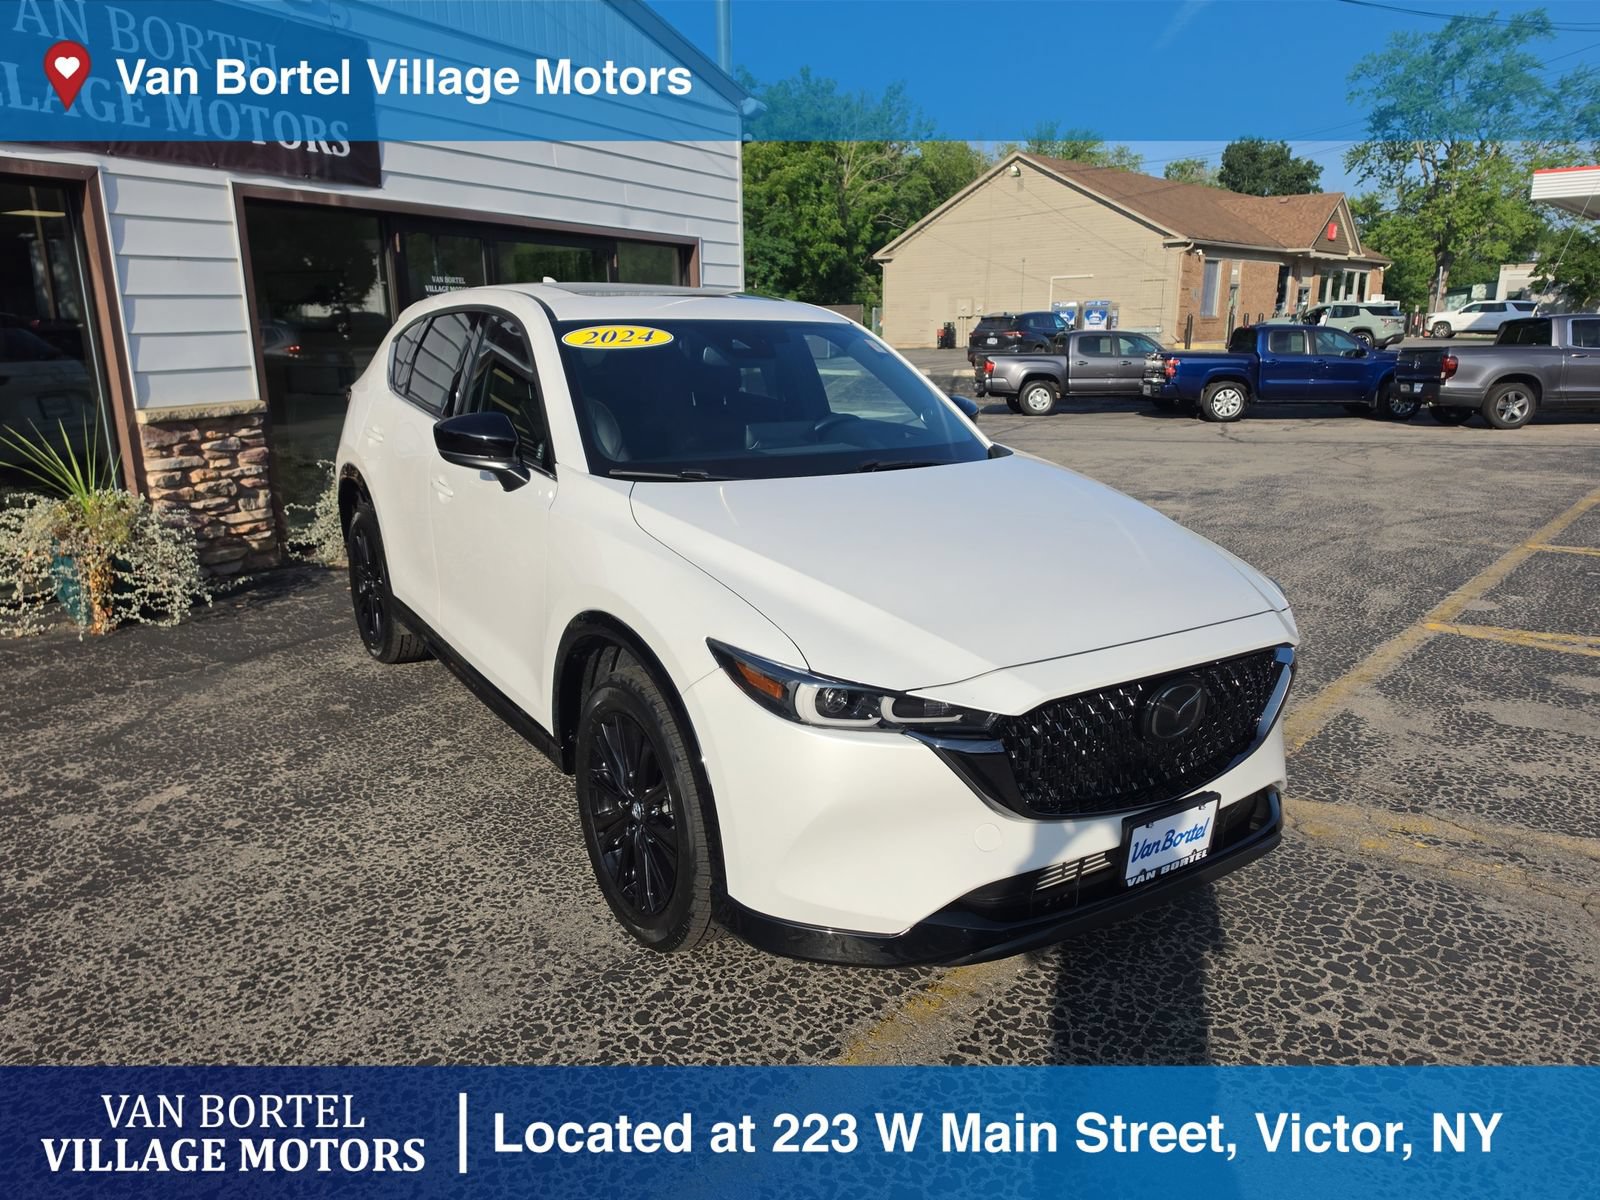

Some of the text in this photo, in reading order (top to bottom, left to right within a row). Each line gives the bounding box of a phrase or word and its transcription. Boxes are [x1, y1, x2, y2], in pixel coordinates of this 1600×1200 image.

[163, 90, 351, 157] MOTORS
[582, 329, 655, 345] 2024
[1131, 816, 1210, 863] Van Bortel
[1126, 849, 1208, 887] VAN BORTEL
